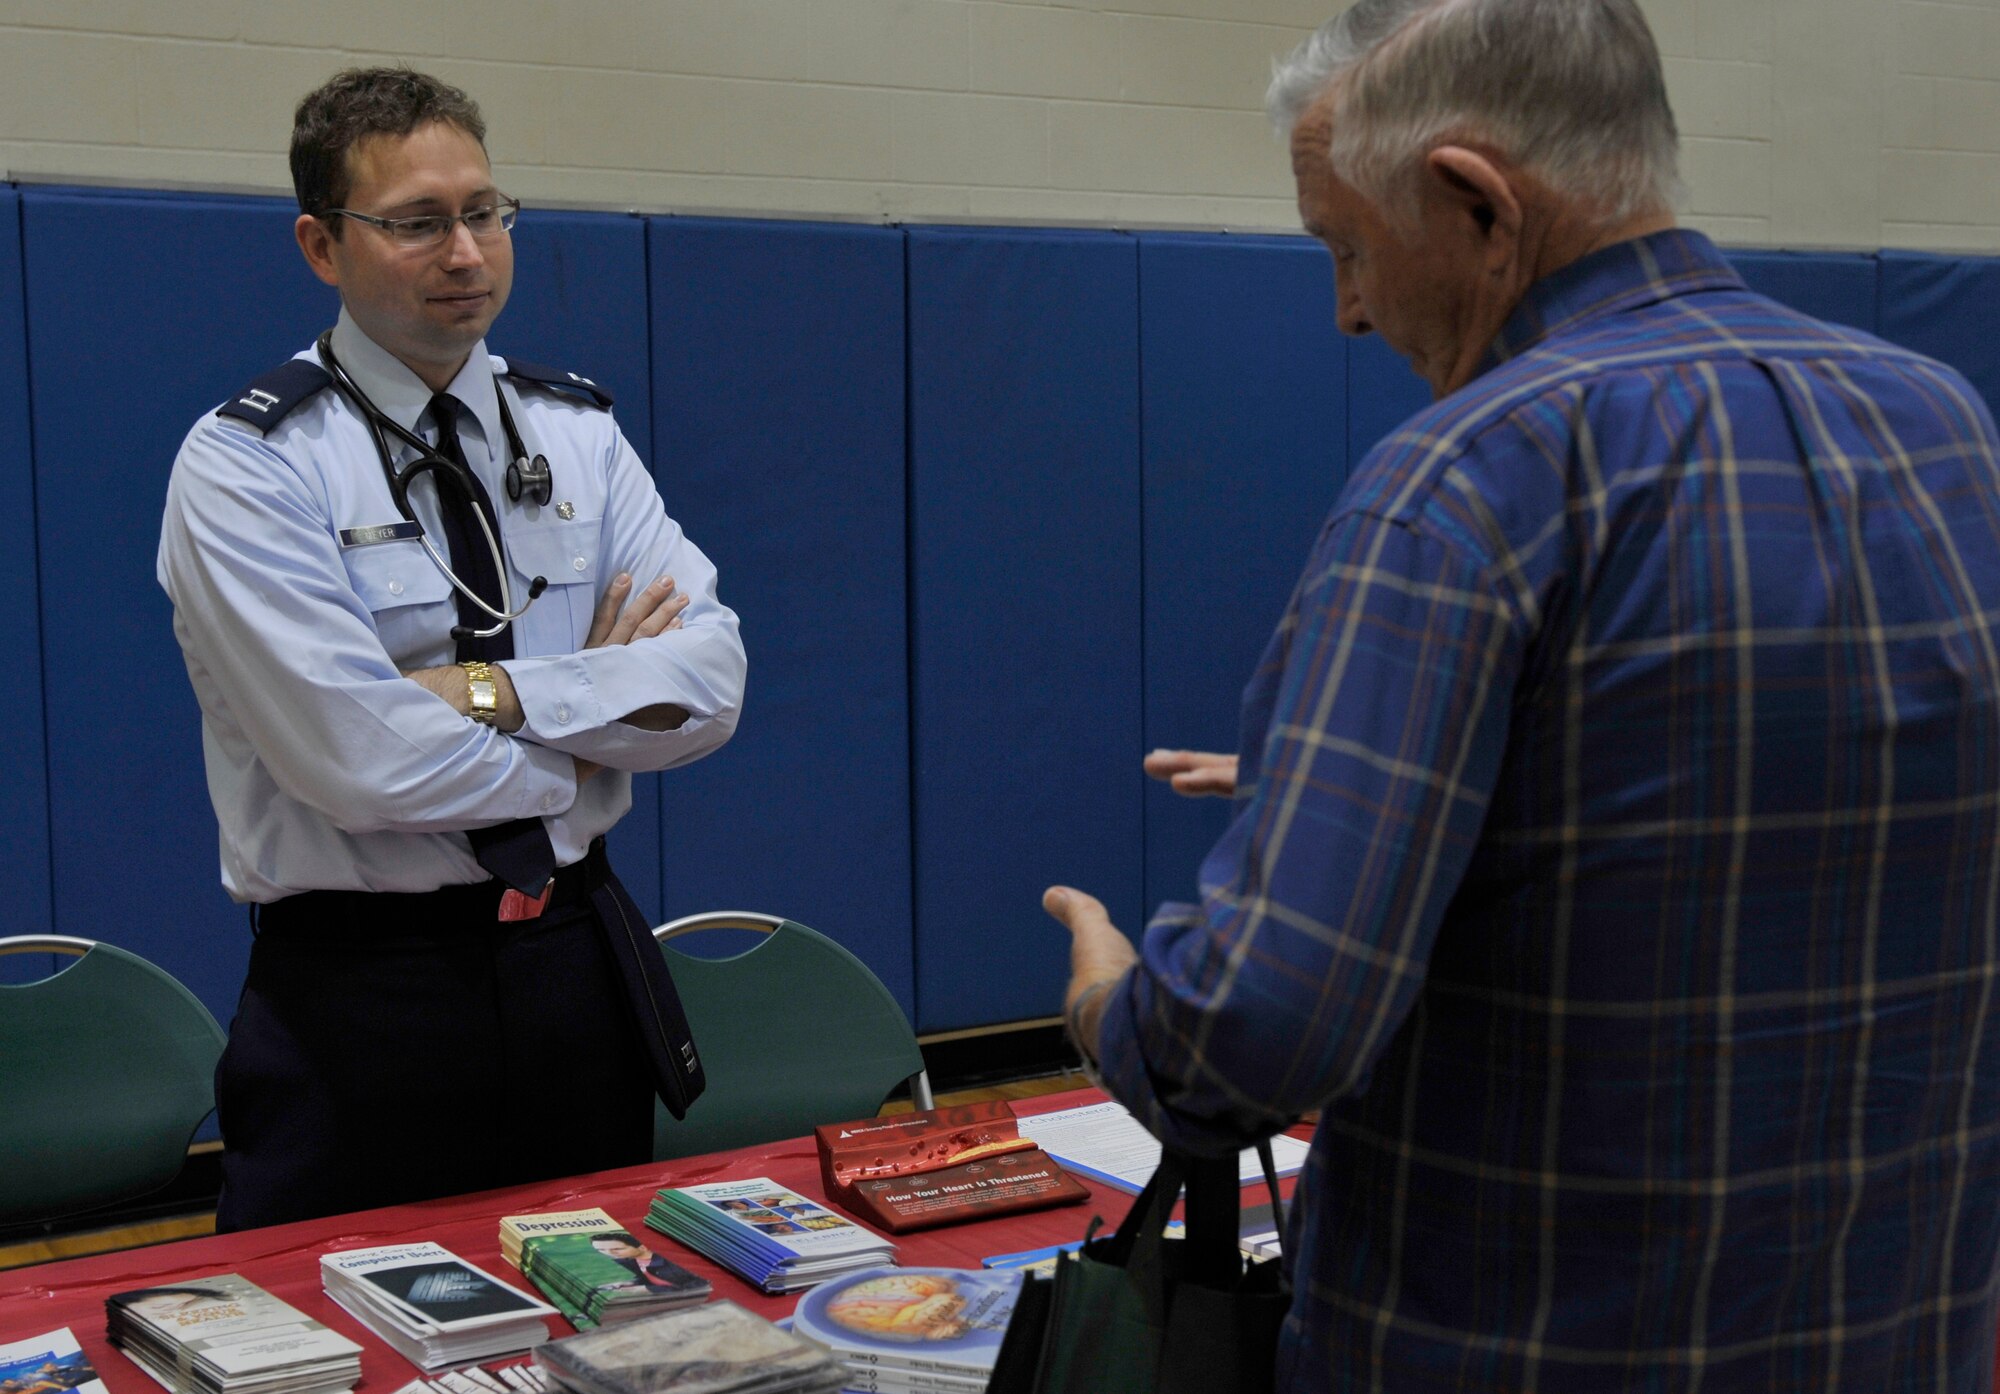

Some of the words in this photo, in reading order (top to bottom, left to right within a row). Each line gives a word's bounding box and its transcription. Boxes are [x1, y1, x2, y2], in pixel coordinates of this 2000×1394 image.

[1030, 1105, 1115, 1124] Cholesterol
[885, 1193, 912, 1203] How
[913, 1188, 939, 1198] Your
[942, 1182, 974, 1194] Heart
[987, 1170, 1049, 1186] Threatened
[515, 1218, 608, 1232] Depression
[339, 1253, 406, 1269] Computer
[407, 1249, 446, 1259] Users
